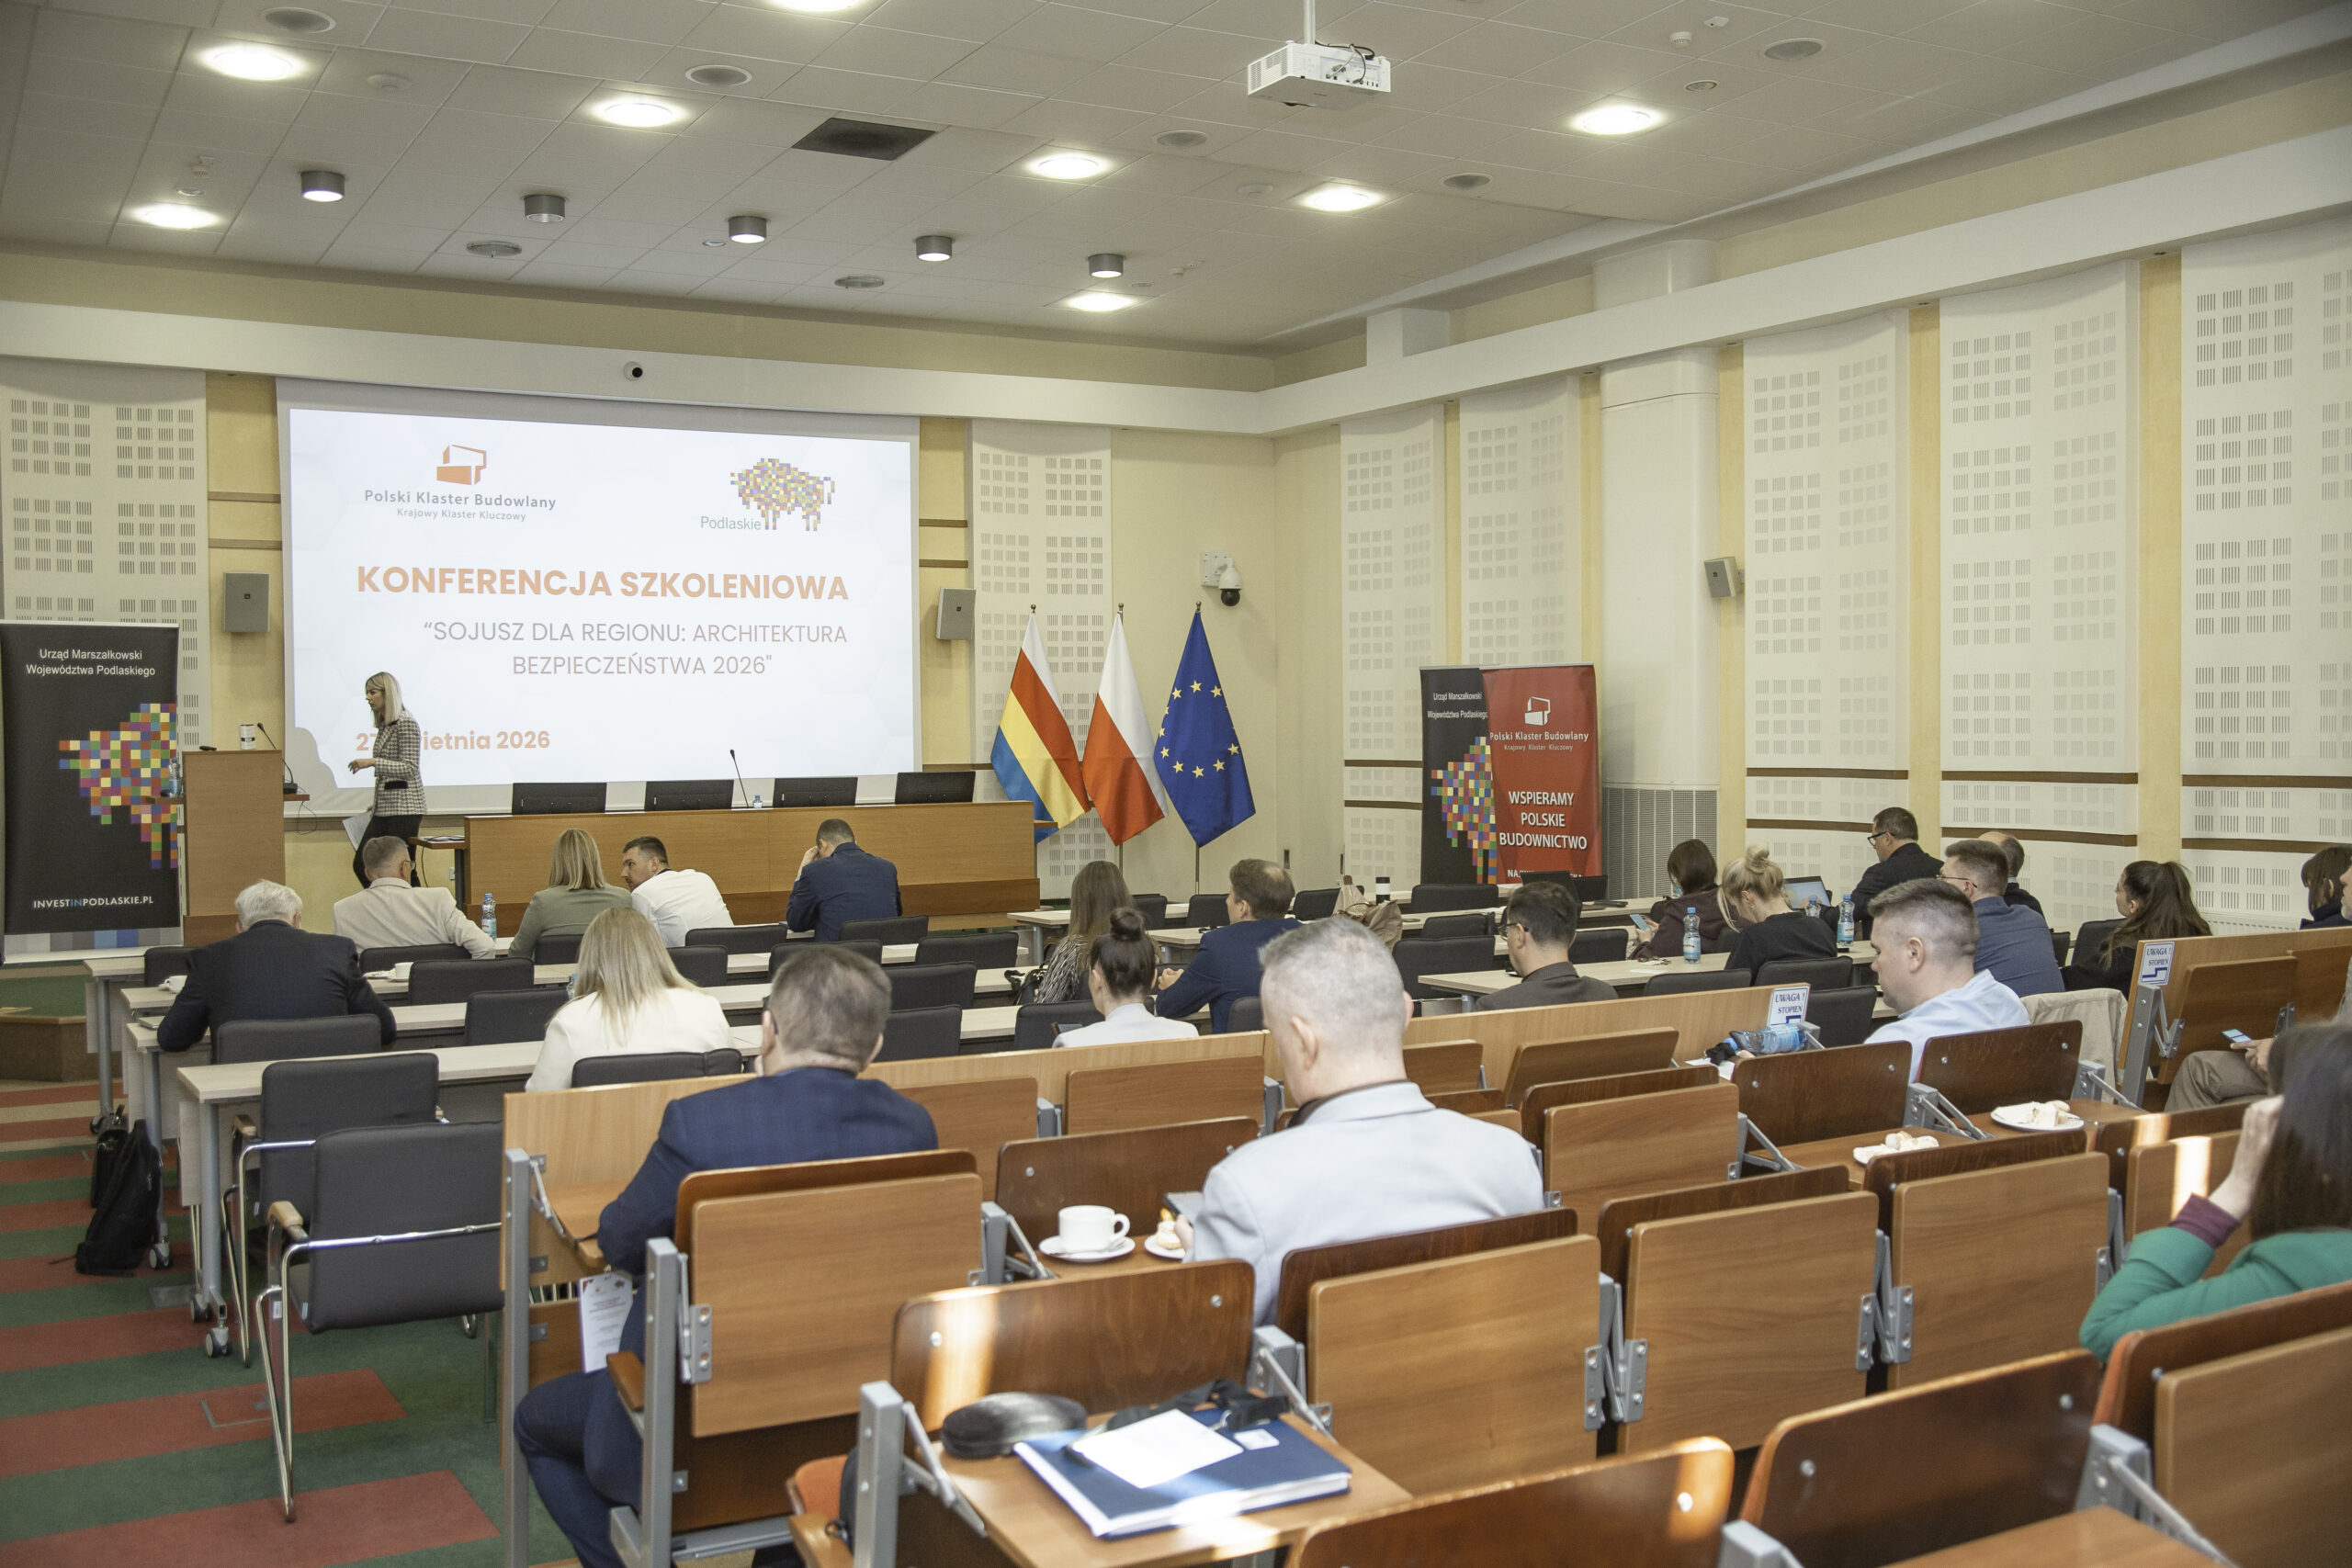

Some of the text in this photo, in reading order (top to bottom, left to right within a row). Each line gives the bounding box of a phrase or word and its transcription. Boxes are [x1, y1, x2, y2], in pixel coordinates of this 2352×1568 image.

[364, 490, 556, 511] Polski Klaster Budowlany
[397, 508, 526, 522] Krajowy Klaster Kluczowy
[700, 515, 762, 530] Podlaskie
[357, 566, 849, 600] KONFERENCJA SZKOLENIOWA
[532, 623, 574, 641] DLA
[582, 623, 685, 642] REGIONU:
[693, 625, 847, 643] ARCHITEKTURA
[40, 649, 142, 660] Urząd Marszałkowski
[513, 652, 707, 674] BEZPIECZEŃSTWA
[26, 664, 156, 678] Województwa Podlaskiego
[356, 732, 378, 751] 2
[496, 730, 550, 750] 2026
[1489, 731, 1589, 742] Polski Klaster Budowlany
[1548, 744, 1574, 752] Kluczowy
[1508, 791, 1575, 806] WSPIERAMY
[1521, 812, 1566, 827] POLSKIE
[1499, 832, 1588, 850] BUDOWNICTWO
[33, 896, 153, 908] INVESTINPODLASKIE.PL
[1775, 993, 1801, 1003] UWAGA
